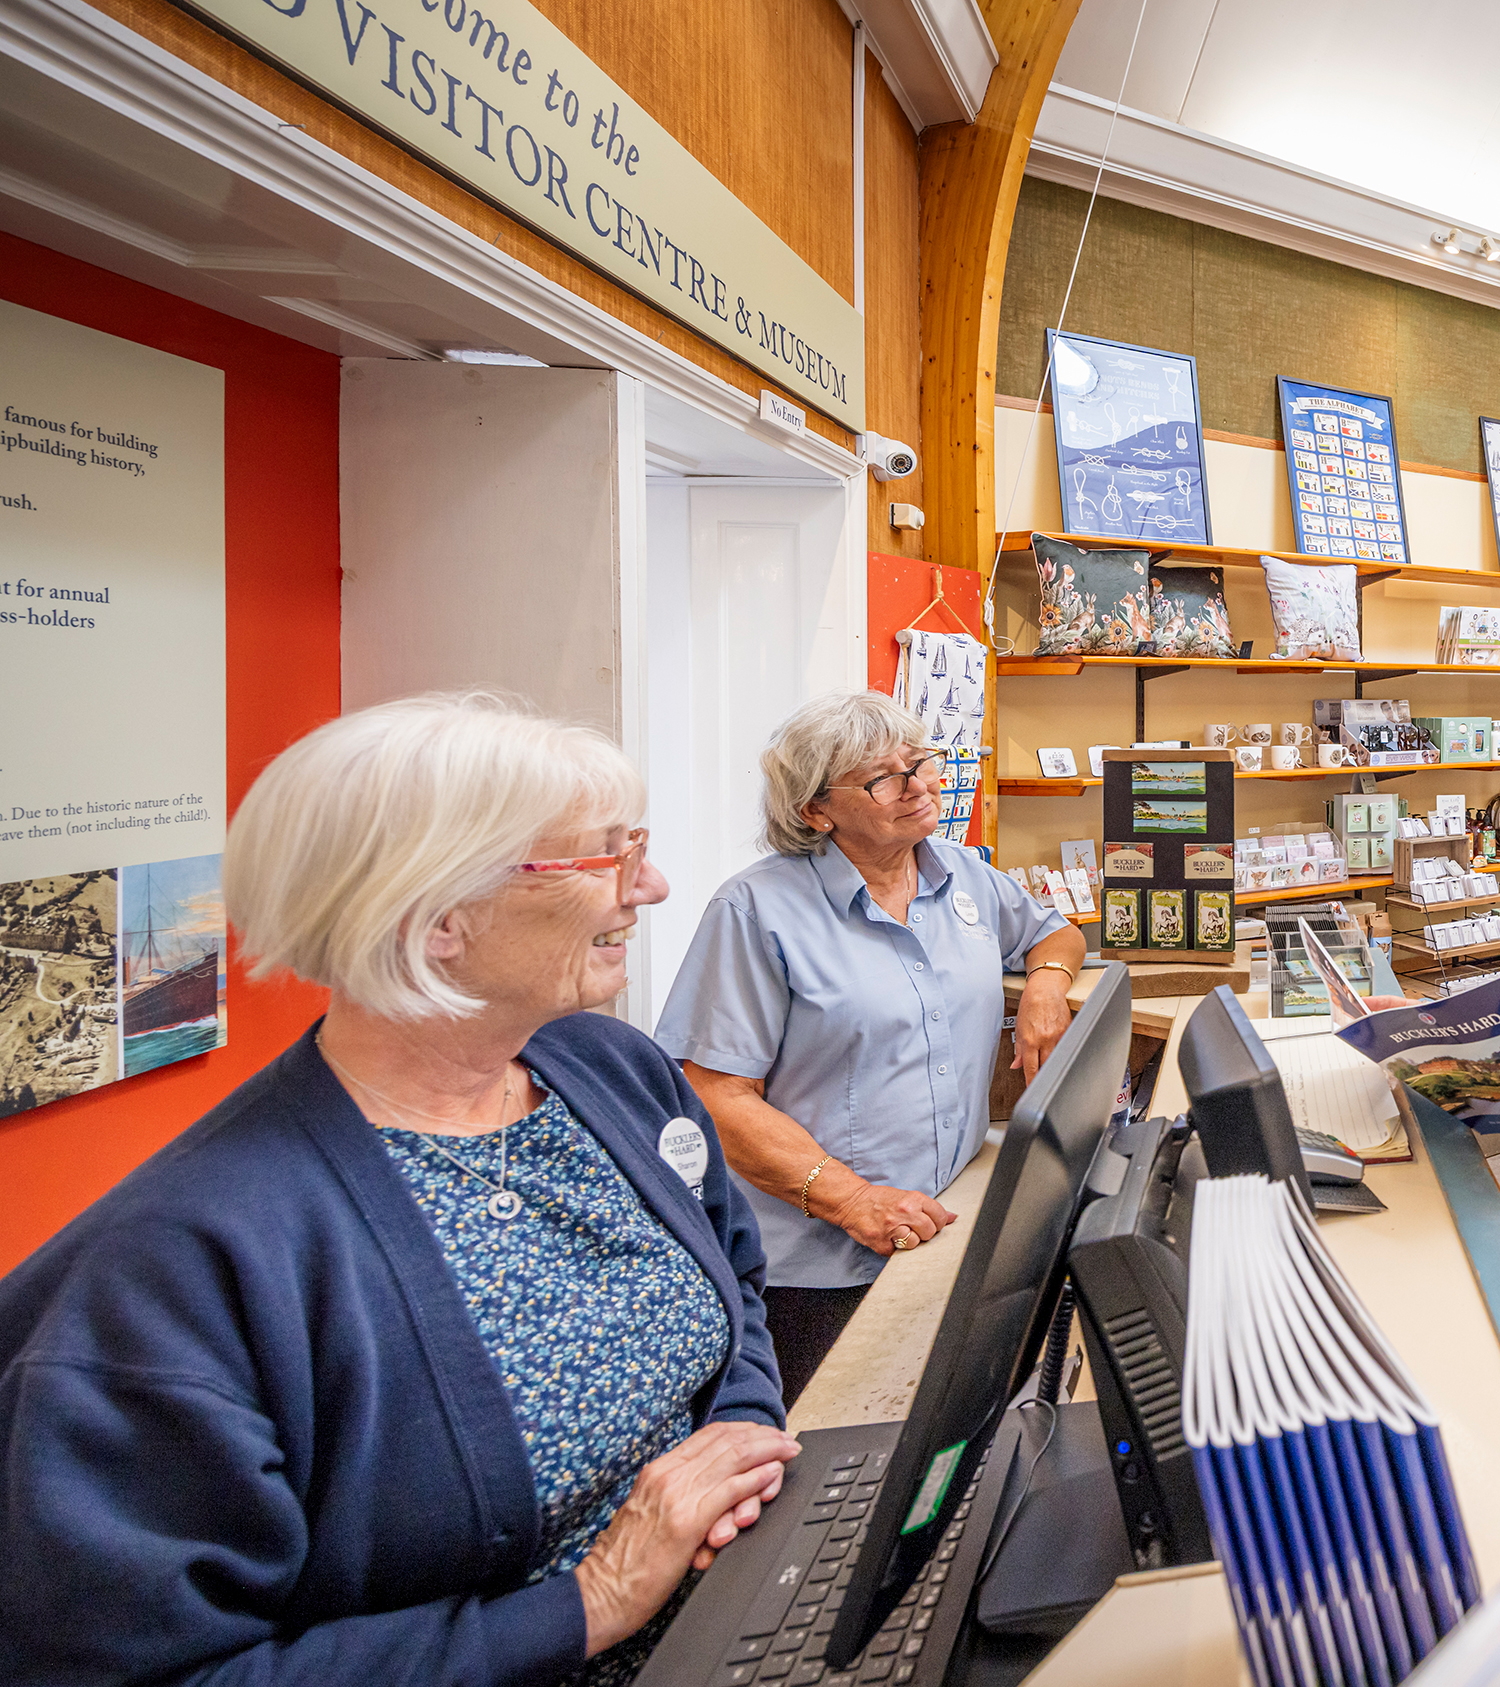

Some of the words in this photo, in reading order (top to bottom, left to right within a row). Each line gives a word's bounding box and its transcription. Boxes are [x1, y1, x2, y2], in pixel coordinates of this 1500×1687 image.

[545, 68, 580, 128] to
[591, 102, 640, 176] the
[335, 0, 577, 219] VISITOR
[586, 182, 728, 322] CENTRE
[735, 296, 753, 339] &
[758, 310, 848, 405] MUSEUM
[770, 399, 782, 419] No
[782, 401, 803, 432] Entry
[1308, 398, 1326, 406] THE
[1327, 399, 1366, 416] ALPHABET
[4, 405, 66, 434] famous
[70, 421, 94, 440] for
[97, 427, 158, 459] building
[90, 448, 146, 477] history,
[16, 578, 45, 599] for
[49, 587, 111, 604] annual
[12, 806, 41, 822] Due
[45, 807, 59, 818] to
[63, 803, 83, 817] the
[86, 799, 132, 815] historic
[134, 798, 170, 810] nature
[172, 793, 186, 807] of
[186, 793, 204, 805] the
[27, 825, 63, 839] them
[66, 821, 92, 837] (not
[95, 815, 152, 832] including
[154, 812, 172, 826] the
[173, 808, 212, 825] child!).
[1112, 858, 1146, 866] BUCKLER'S
[1192, 860, 1226, 868] BUCKLER'S
[1389, 1025, 1460, 1044] BUCKLER'S
[664, 1131, 702, 1148] BUCKLER'S
[674, 1143, 697, 1157] HARD
